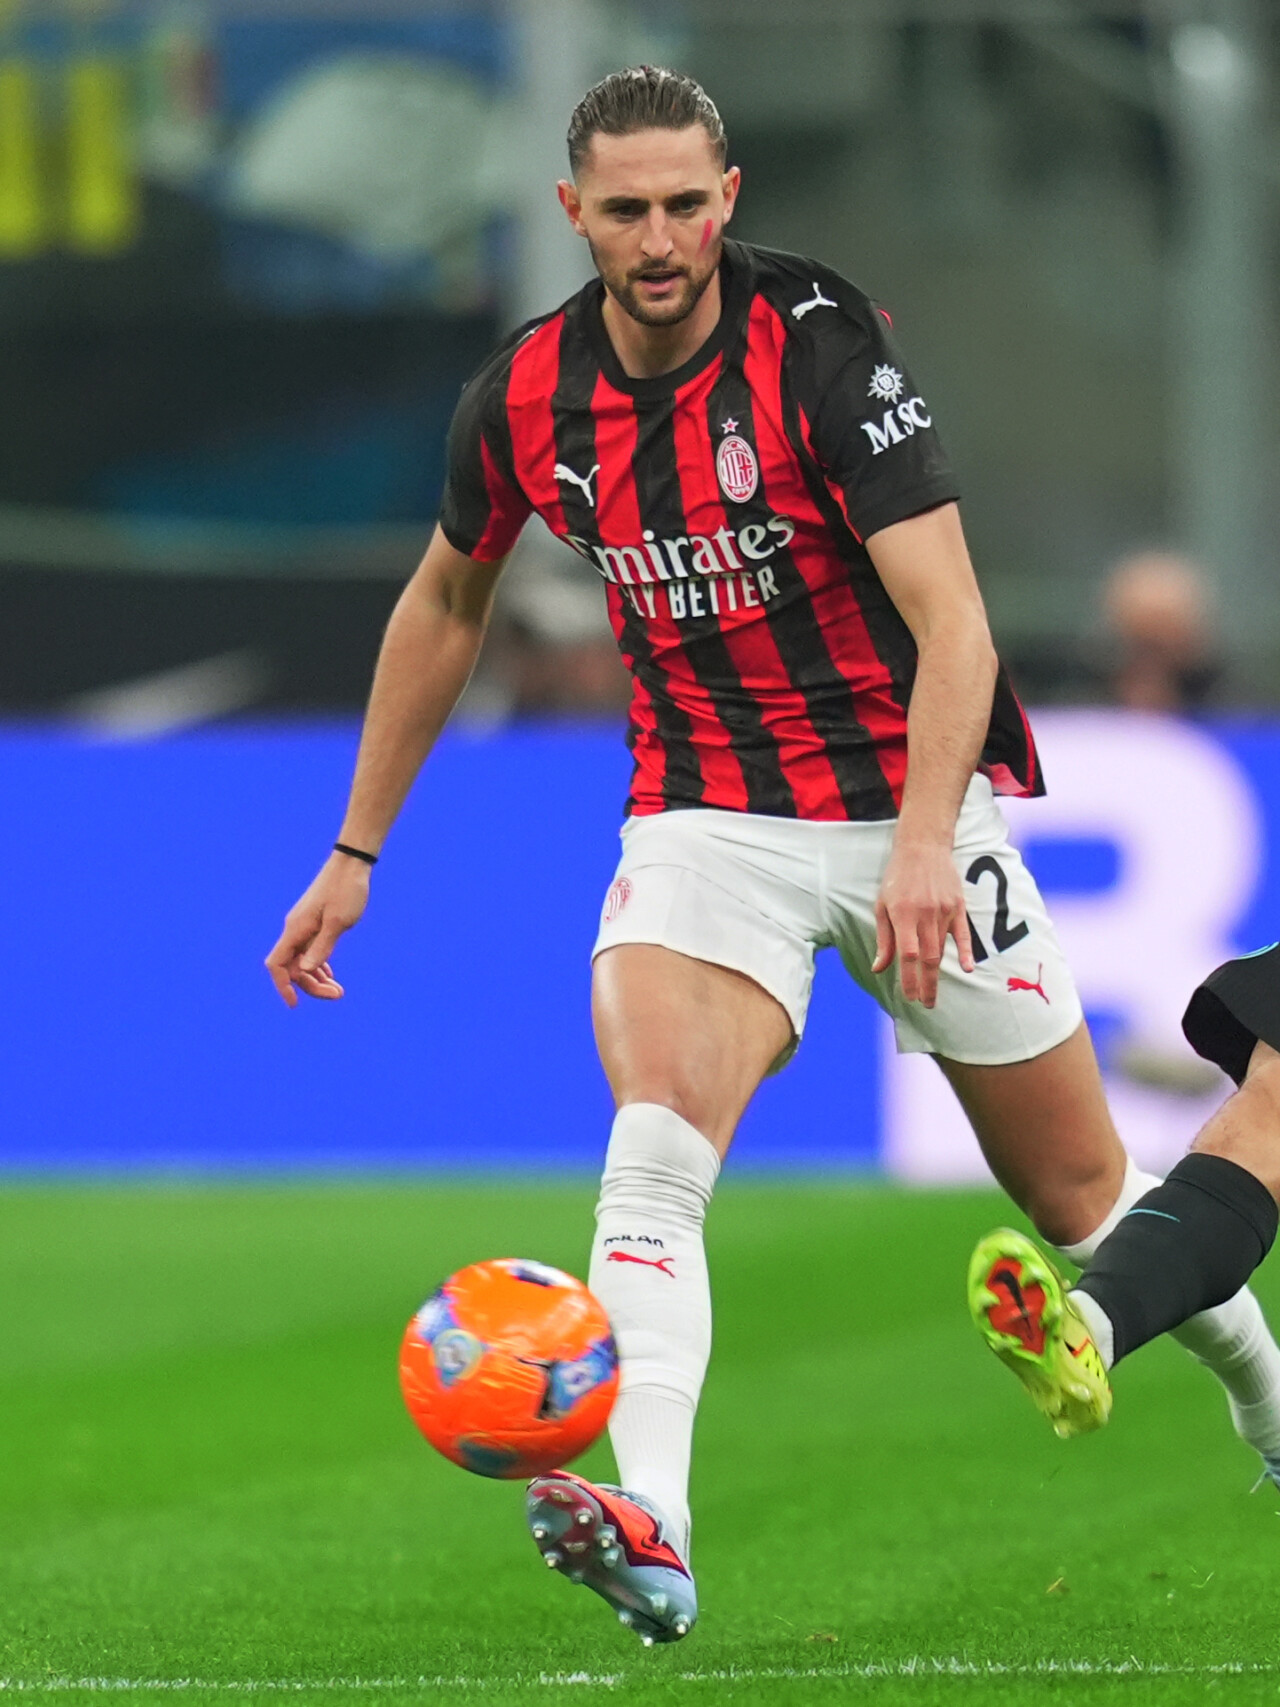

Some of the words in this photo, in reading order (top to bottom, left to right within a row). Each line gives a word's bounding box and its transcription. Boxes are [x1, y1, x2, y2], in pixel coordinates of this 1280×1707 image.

[860, 396, 931, 455] MSC
[618, 581, 658, 619] LY
[667, 565, 781, 620] BETTER
